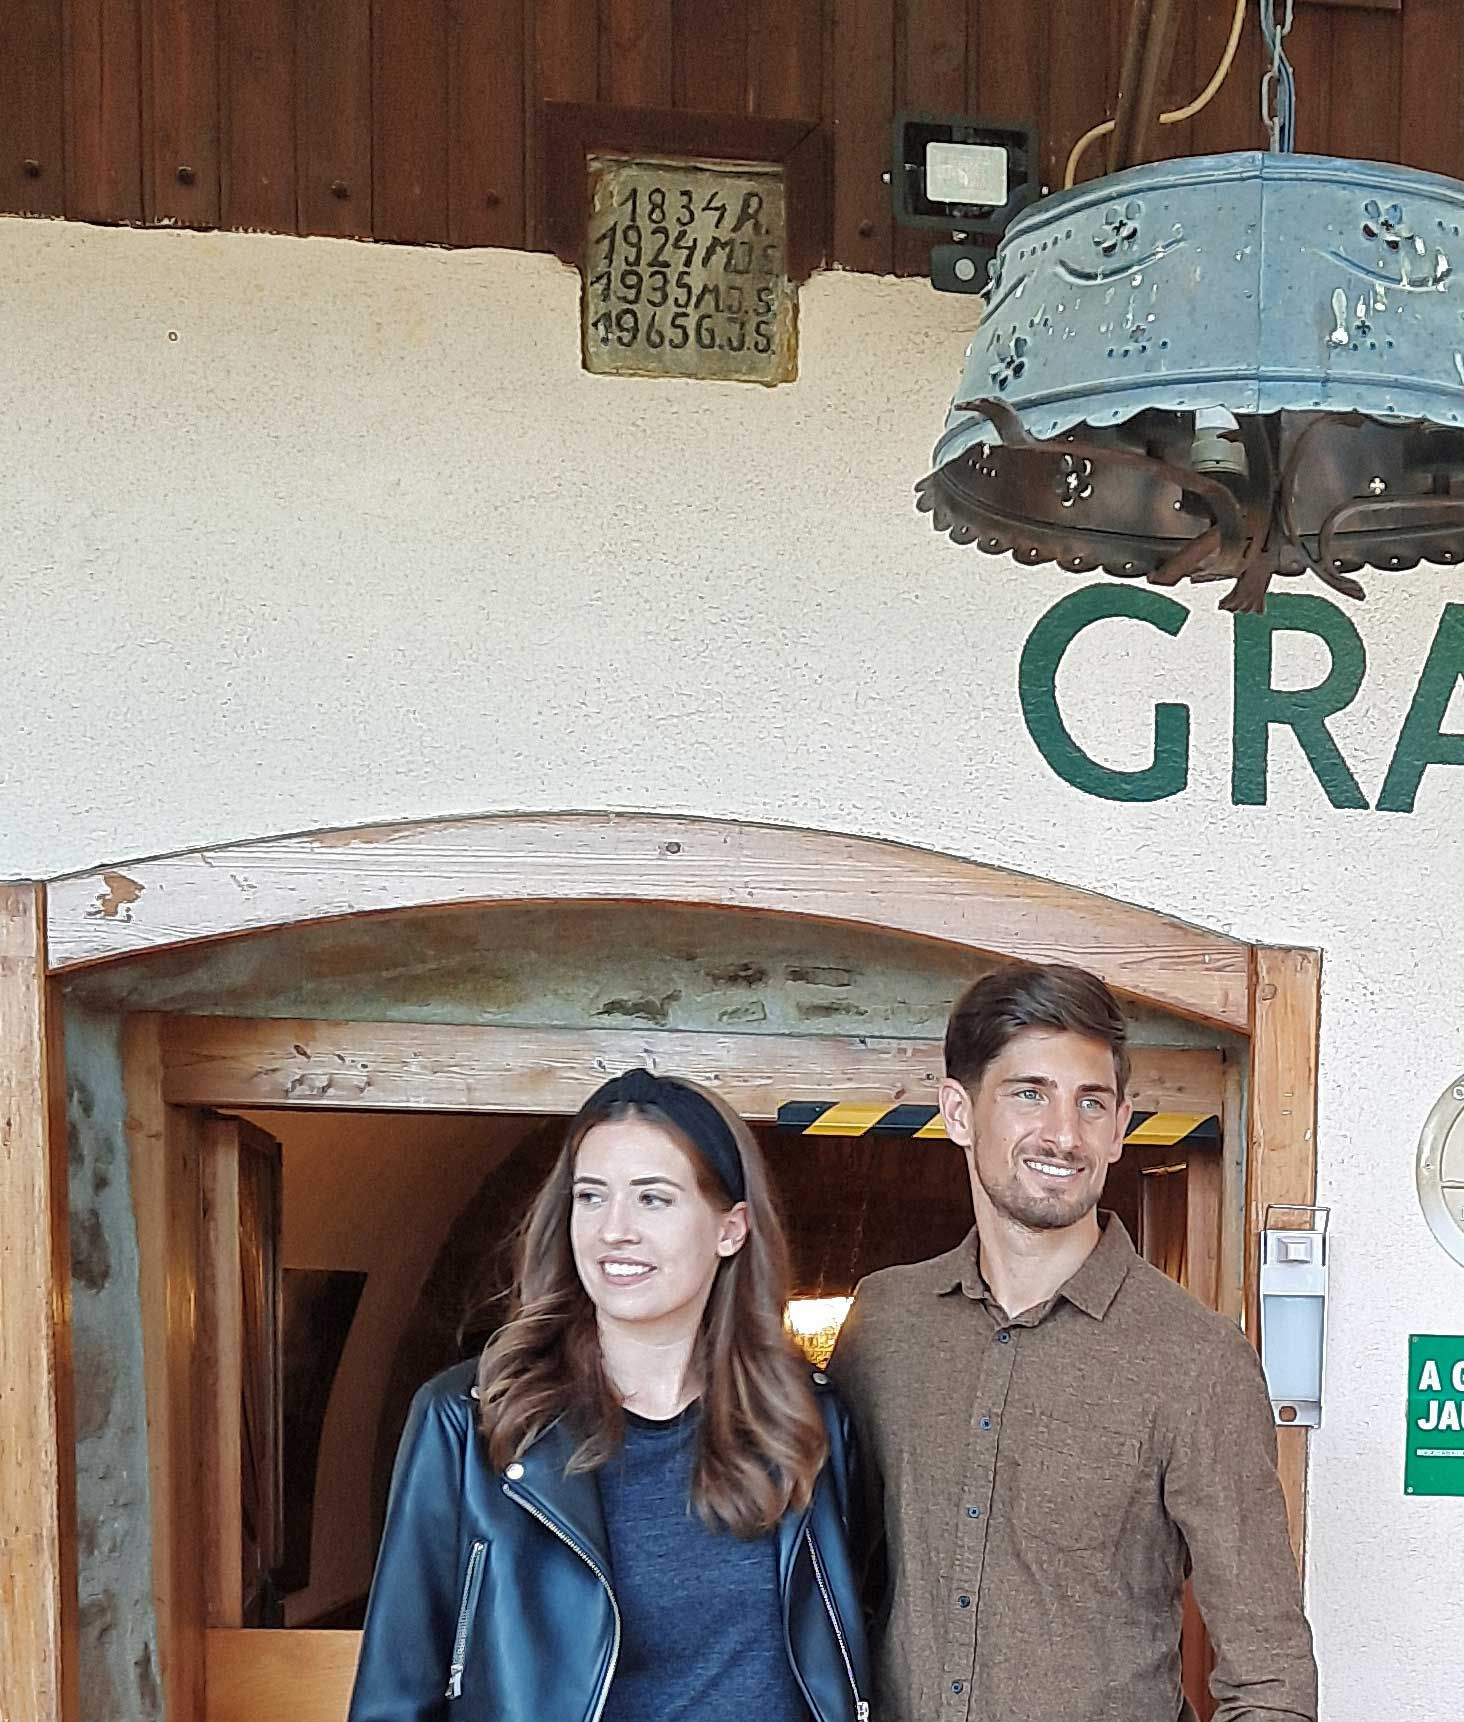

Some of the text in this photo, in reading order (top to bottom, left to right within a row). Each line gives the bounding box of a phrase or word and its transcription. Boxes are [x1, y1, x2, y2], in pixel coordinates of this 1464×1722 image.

[617, 186, 728, 229] 1834
[594, 220, 698, 269] 1924
[589, 269, 693, 308] 1935
[591, 307, 690, 349] 1965
[1418, 1360, 1442, 1392] A
